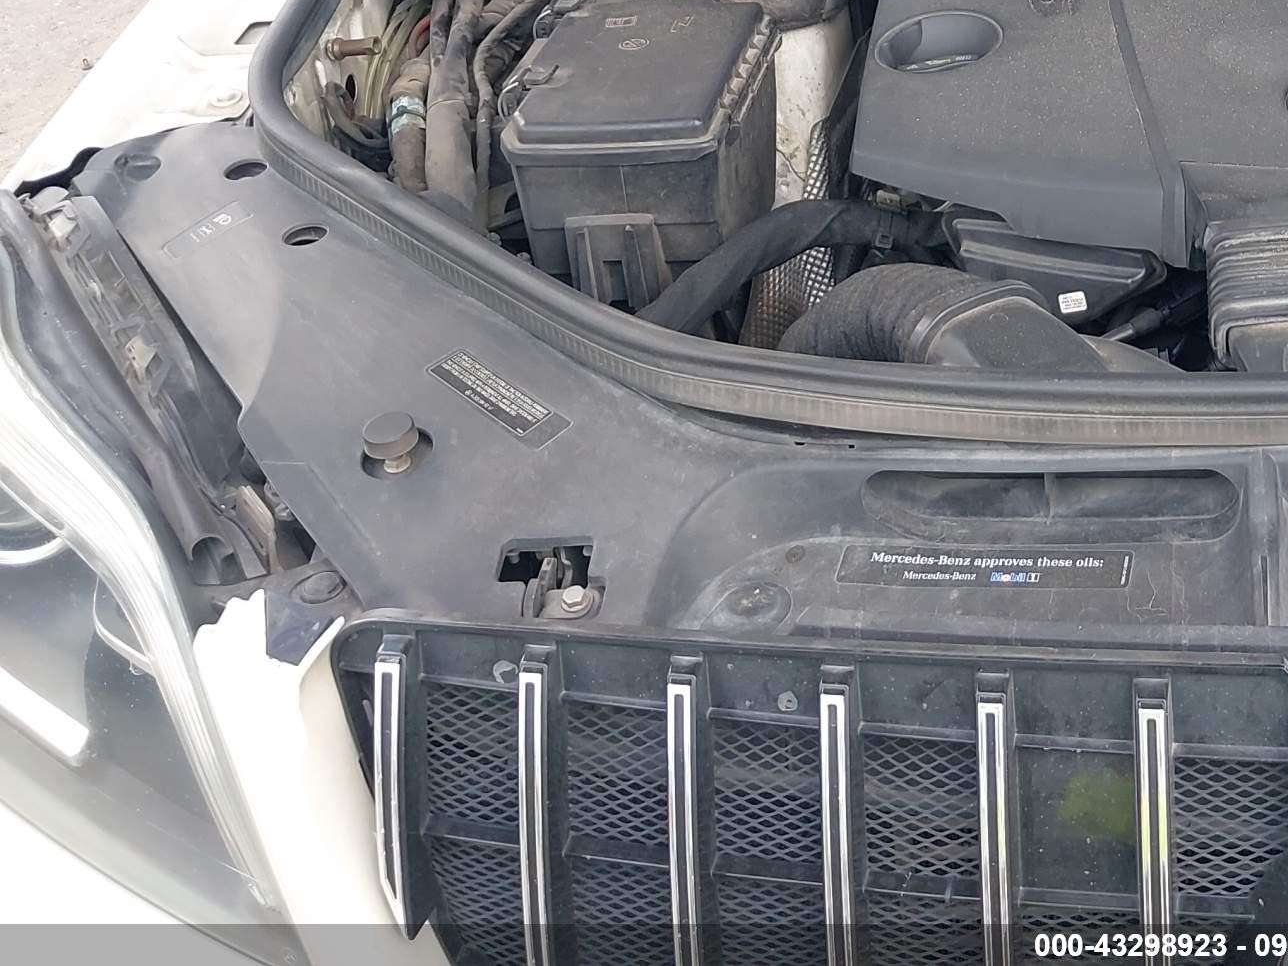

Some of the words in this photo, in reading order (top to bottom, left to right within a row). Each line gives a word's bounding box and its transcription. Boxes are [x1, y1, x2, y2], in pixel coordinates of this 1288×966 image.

[870, 552, 972, 566] Mercedes-Benz
[973, 558, 1034, 568] approves
[1037, 556, 1073, 567] these
[1075, 557, 1104, 567] oils:
[902, 571, 977, 580] Mercedes-Benz
